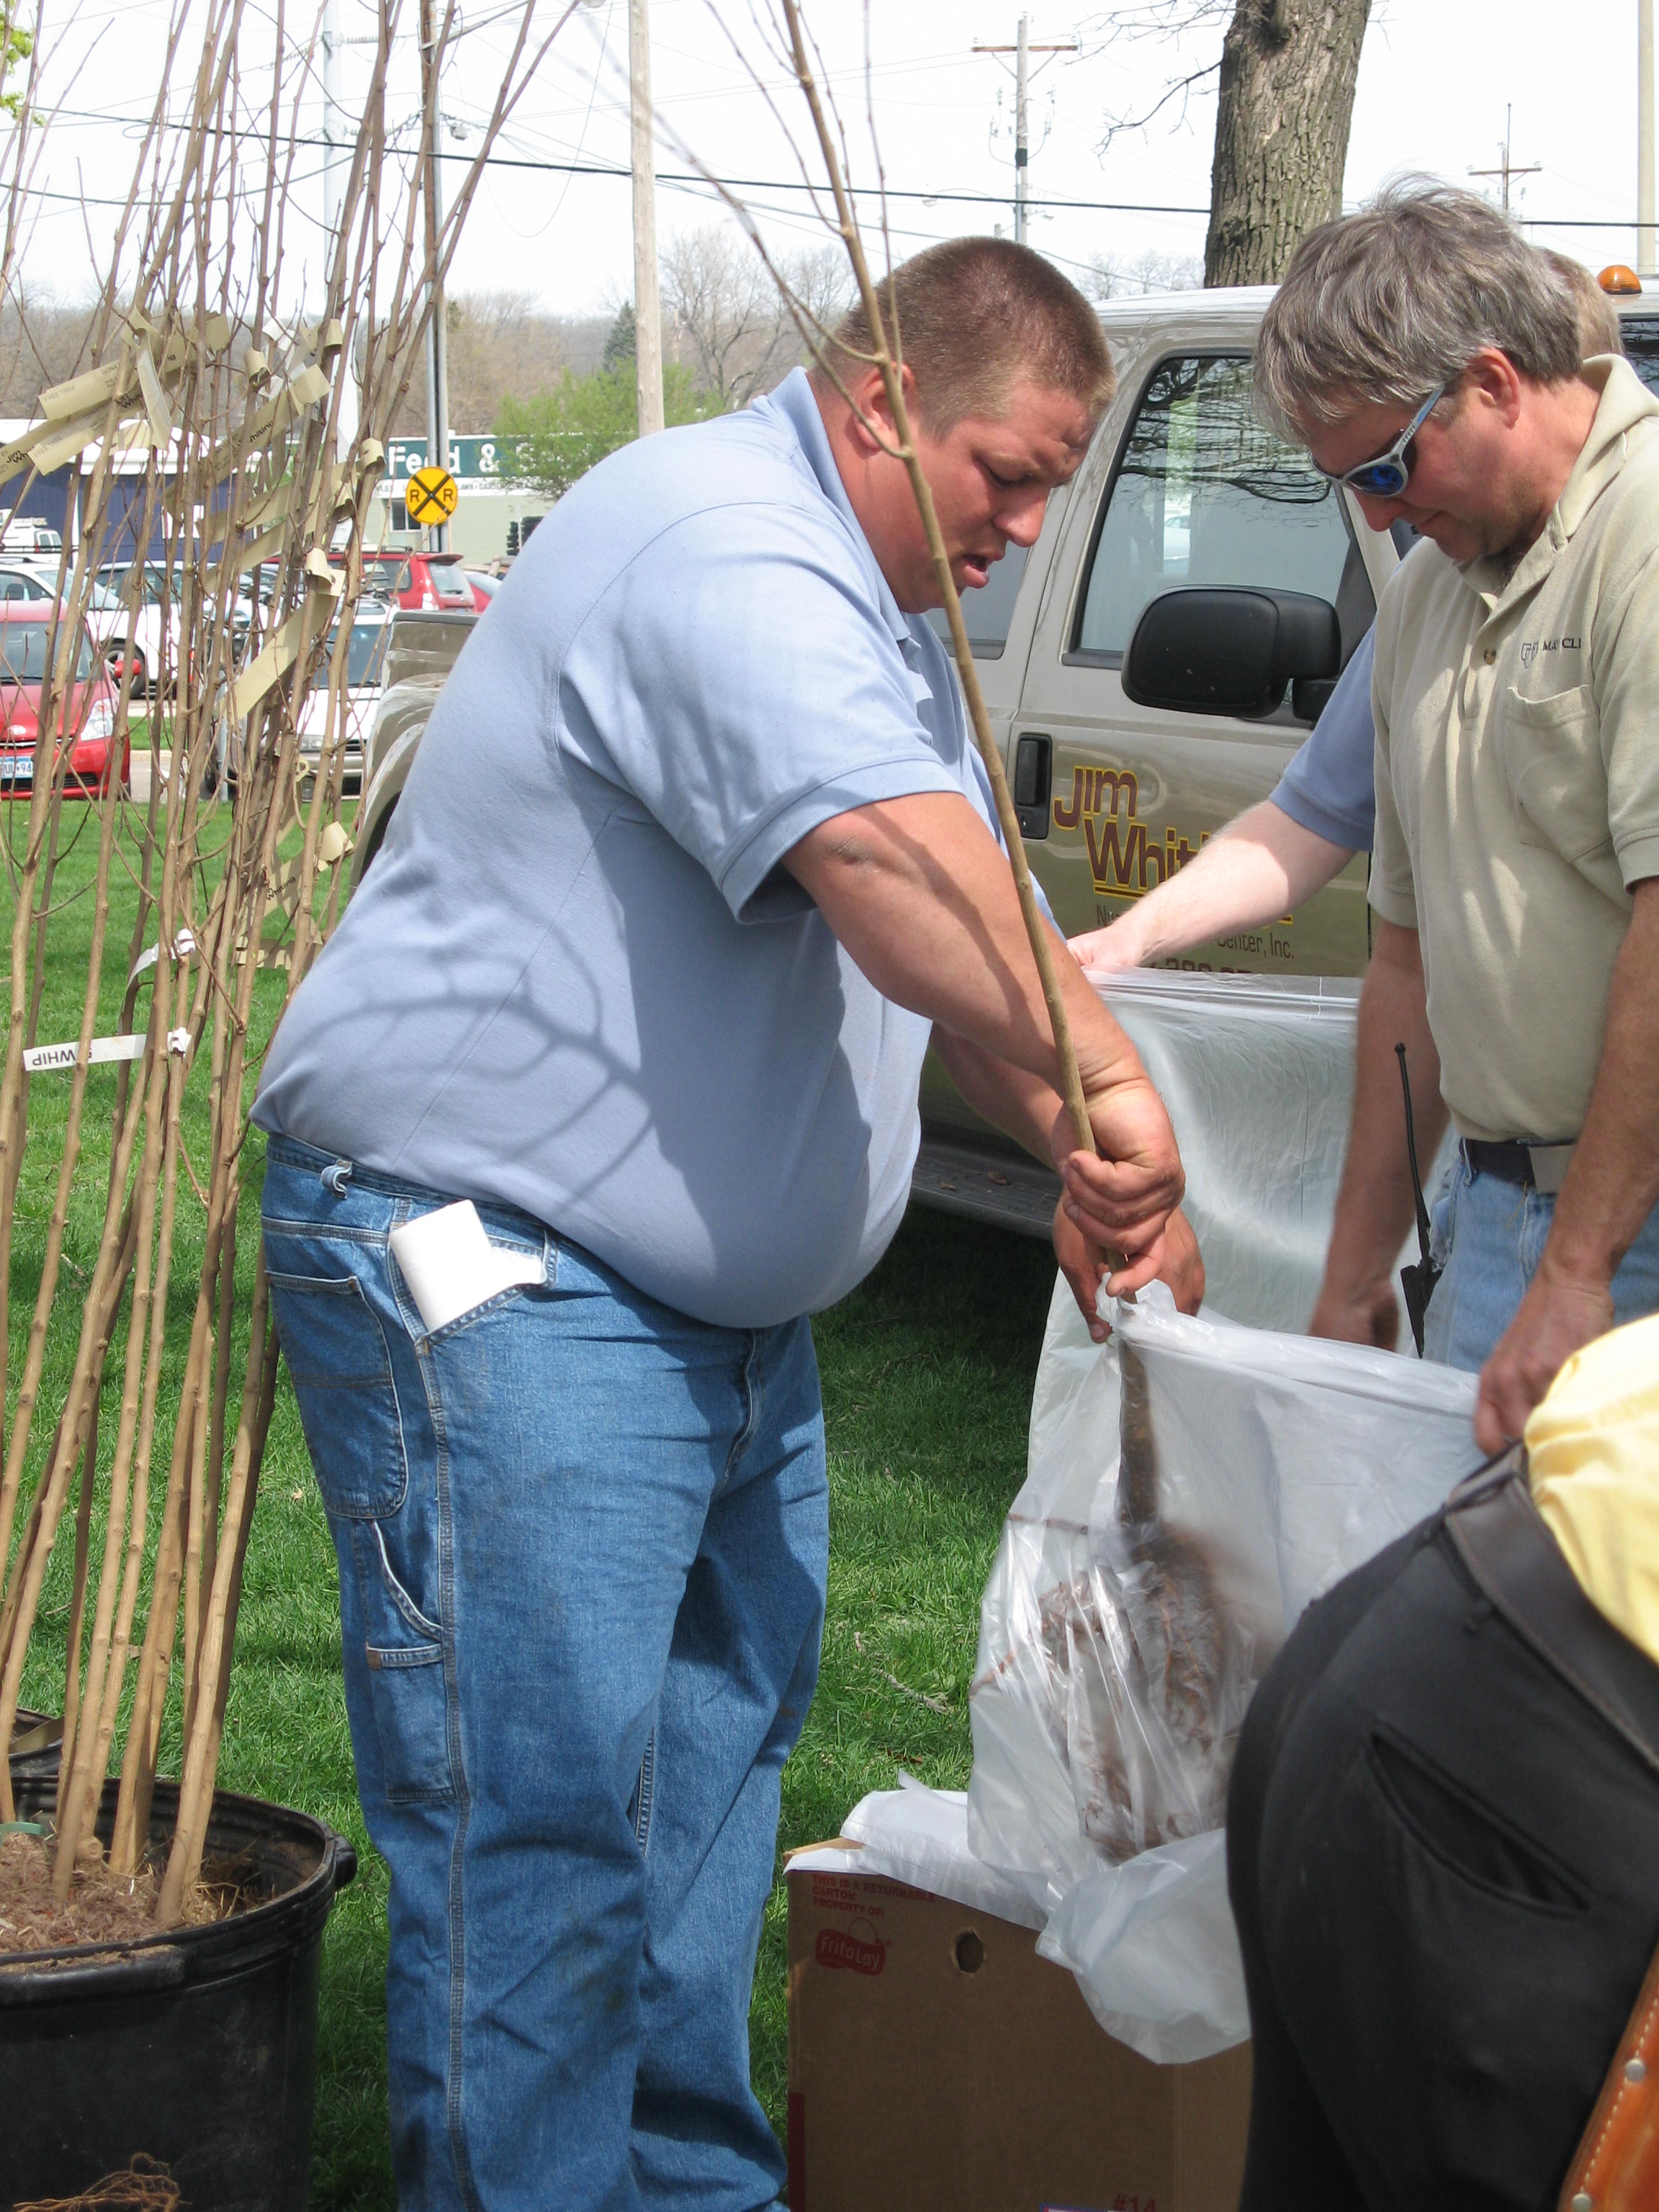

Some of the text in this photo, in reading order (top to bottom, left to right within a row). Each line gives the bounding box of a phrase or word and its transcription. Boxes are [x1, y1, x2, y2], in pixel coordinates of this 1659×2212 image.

[388, 444, 461, 475] Fed
[479, 443, 500, 473] &
[410, 488, 454, 503] R R
[1053, 765, 1139, 830] Jim
[1083, 816, 1211, 891] Whit
[1270, 932, 1295, 959] Inc.
[32, 1049, 76, 1066] WHIP
[811, 1873, 936, 1902] THIS IS A RETURNABLE
[811, 1886, 856, 1901] CARTON
[812, 1897, 866, 1913] PROPERTY
